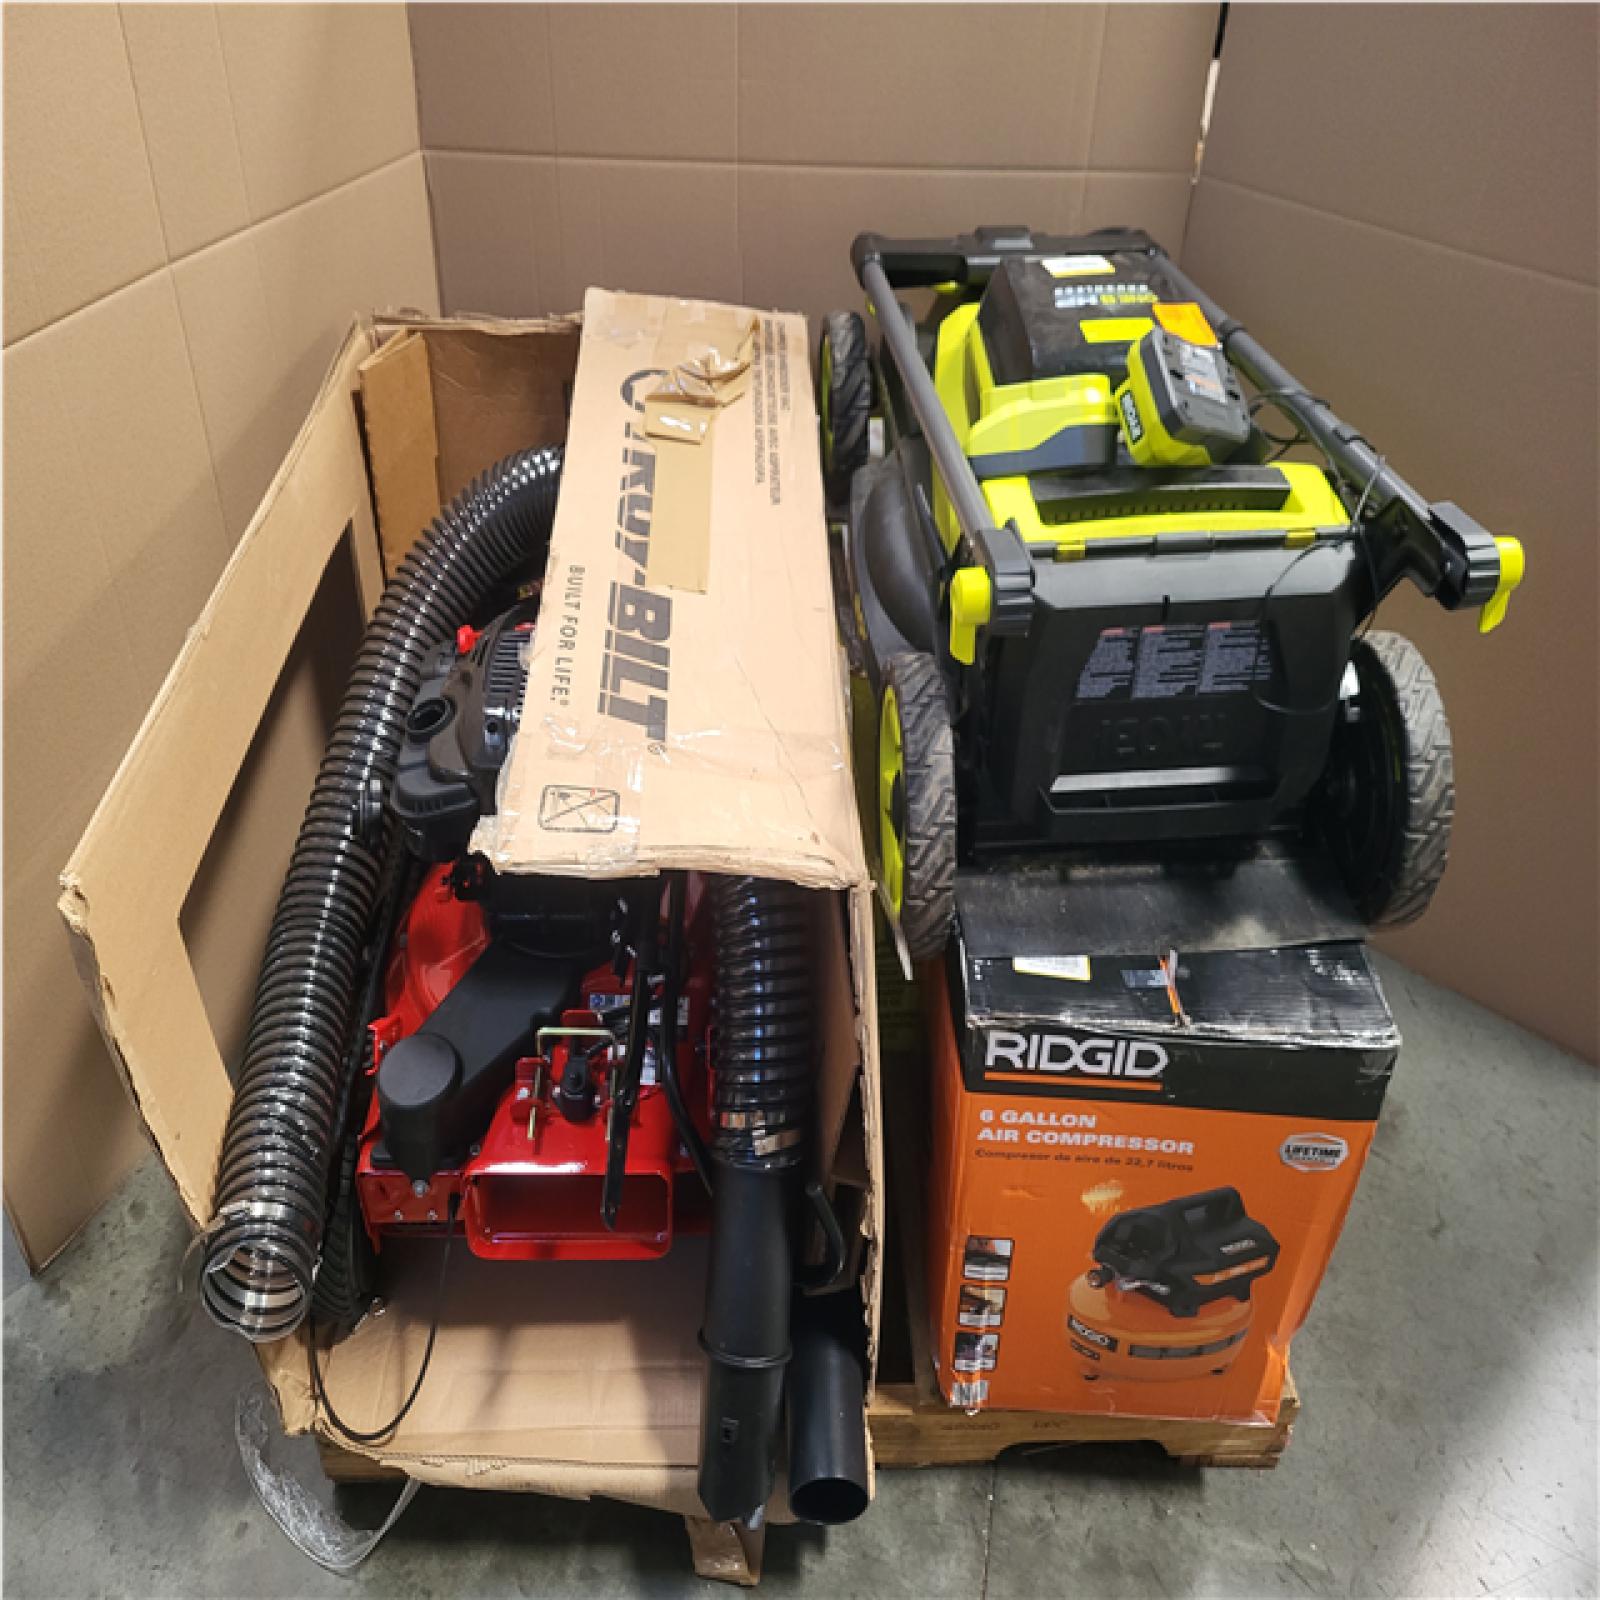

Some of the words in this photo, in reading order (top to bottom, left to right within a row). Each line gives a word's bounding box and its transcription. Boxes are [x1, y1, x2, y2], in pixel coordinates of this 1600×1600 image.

[565, 566, 586, 609] BUILT
[557, 615, 579, 650] FOR
[985, 1031, 1169, 1077] RIDGID
[1000, 1110, 1096, 1128] GALLON
[977, 1127, 1019, 1143] AIR
[1027, 1131, 1194, 1154] COMPRESSOR
[1284, 1144, 1341, 1157] LIFETIME
